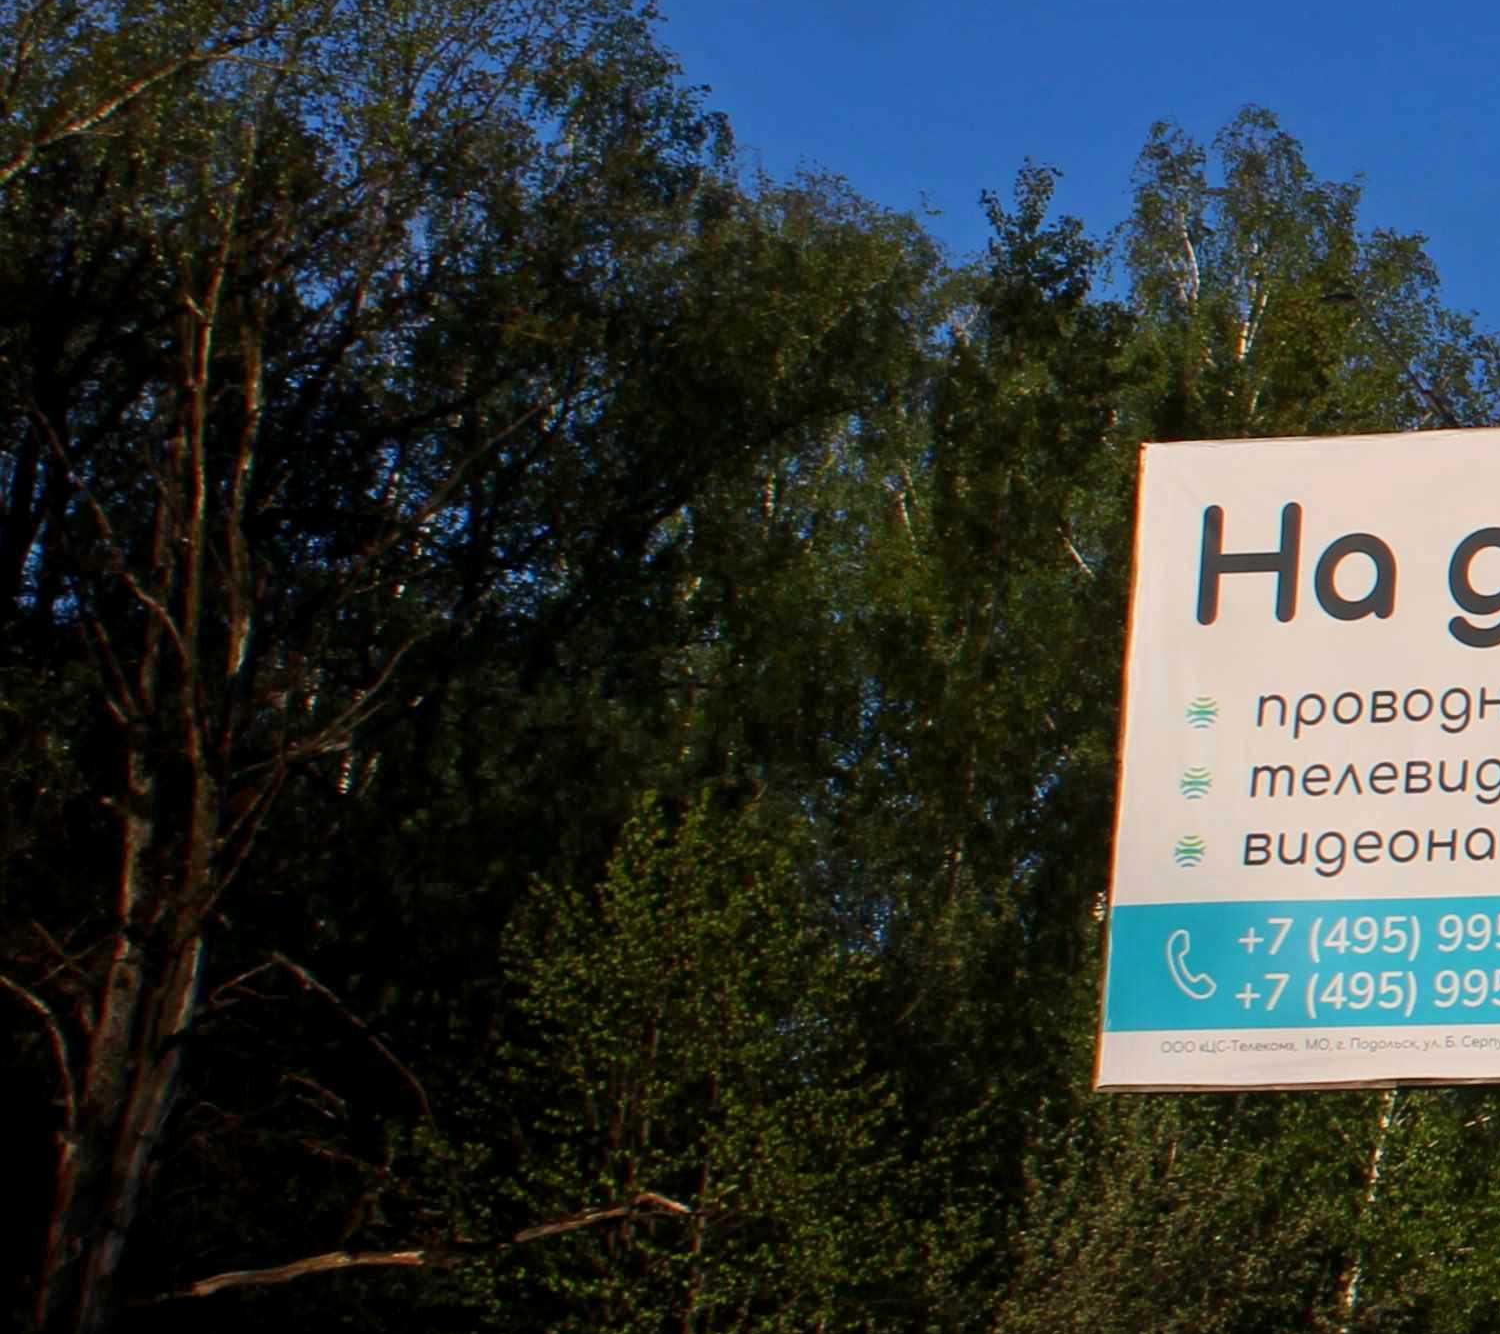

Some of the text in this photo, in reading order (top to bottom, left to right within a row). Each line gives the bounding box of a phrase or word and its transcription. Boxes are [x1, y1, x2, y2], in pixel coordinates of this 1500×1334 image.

[1196, 501, 1397, 627] На
[1237, 918, 1294, 955] +7
[1308, 913, 1422, 963] (495)
[1234, 974, 1291, 1012] +7
[1304, 969, 1419, 1020] (495)
[1160, 1040, 1196, 1053] ООО
